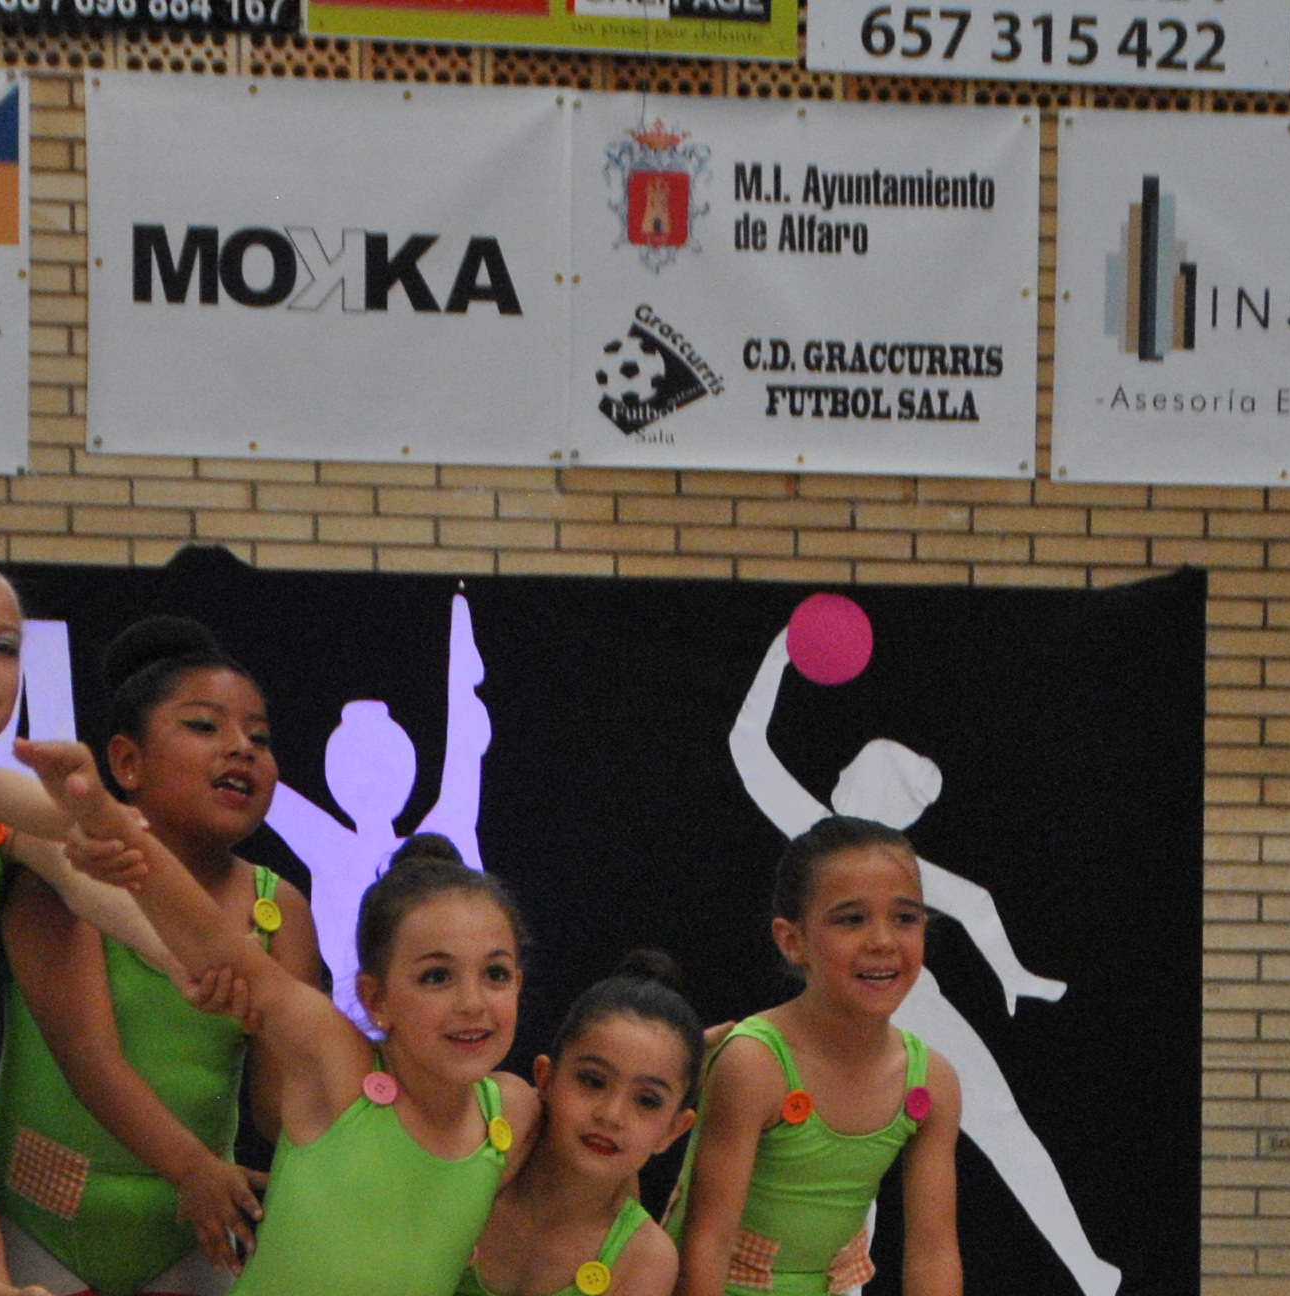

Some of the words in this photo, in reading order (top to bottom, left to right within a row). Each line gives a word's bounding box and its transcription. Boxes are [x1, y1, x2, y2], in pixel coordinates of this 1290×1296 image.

[860, 6, 972, 60] 657
[991, 12, 1100, 66] 315
[1117, 17, 1227, 72] 422
[733, 161, 791, 202] M.I.
[801, 163, 996, 211] Ayuntamiento
[733, 212, 768, 252] de
[778, 213, 869, 255] Alfaro
[742, 337, 797, 372] C.D.
[802, 340, 1004, 378] GRACCURRIS
[764, 384, 892, 419] FUTBOL
[897, 387, 980, 422] SALA
